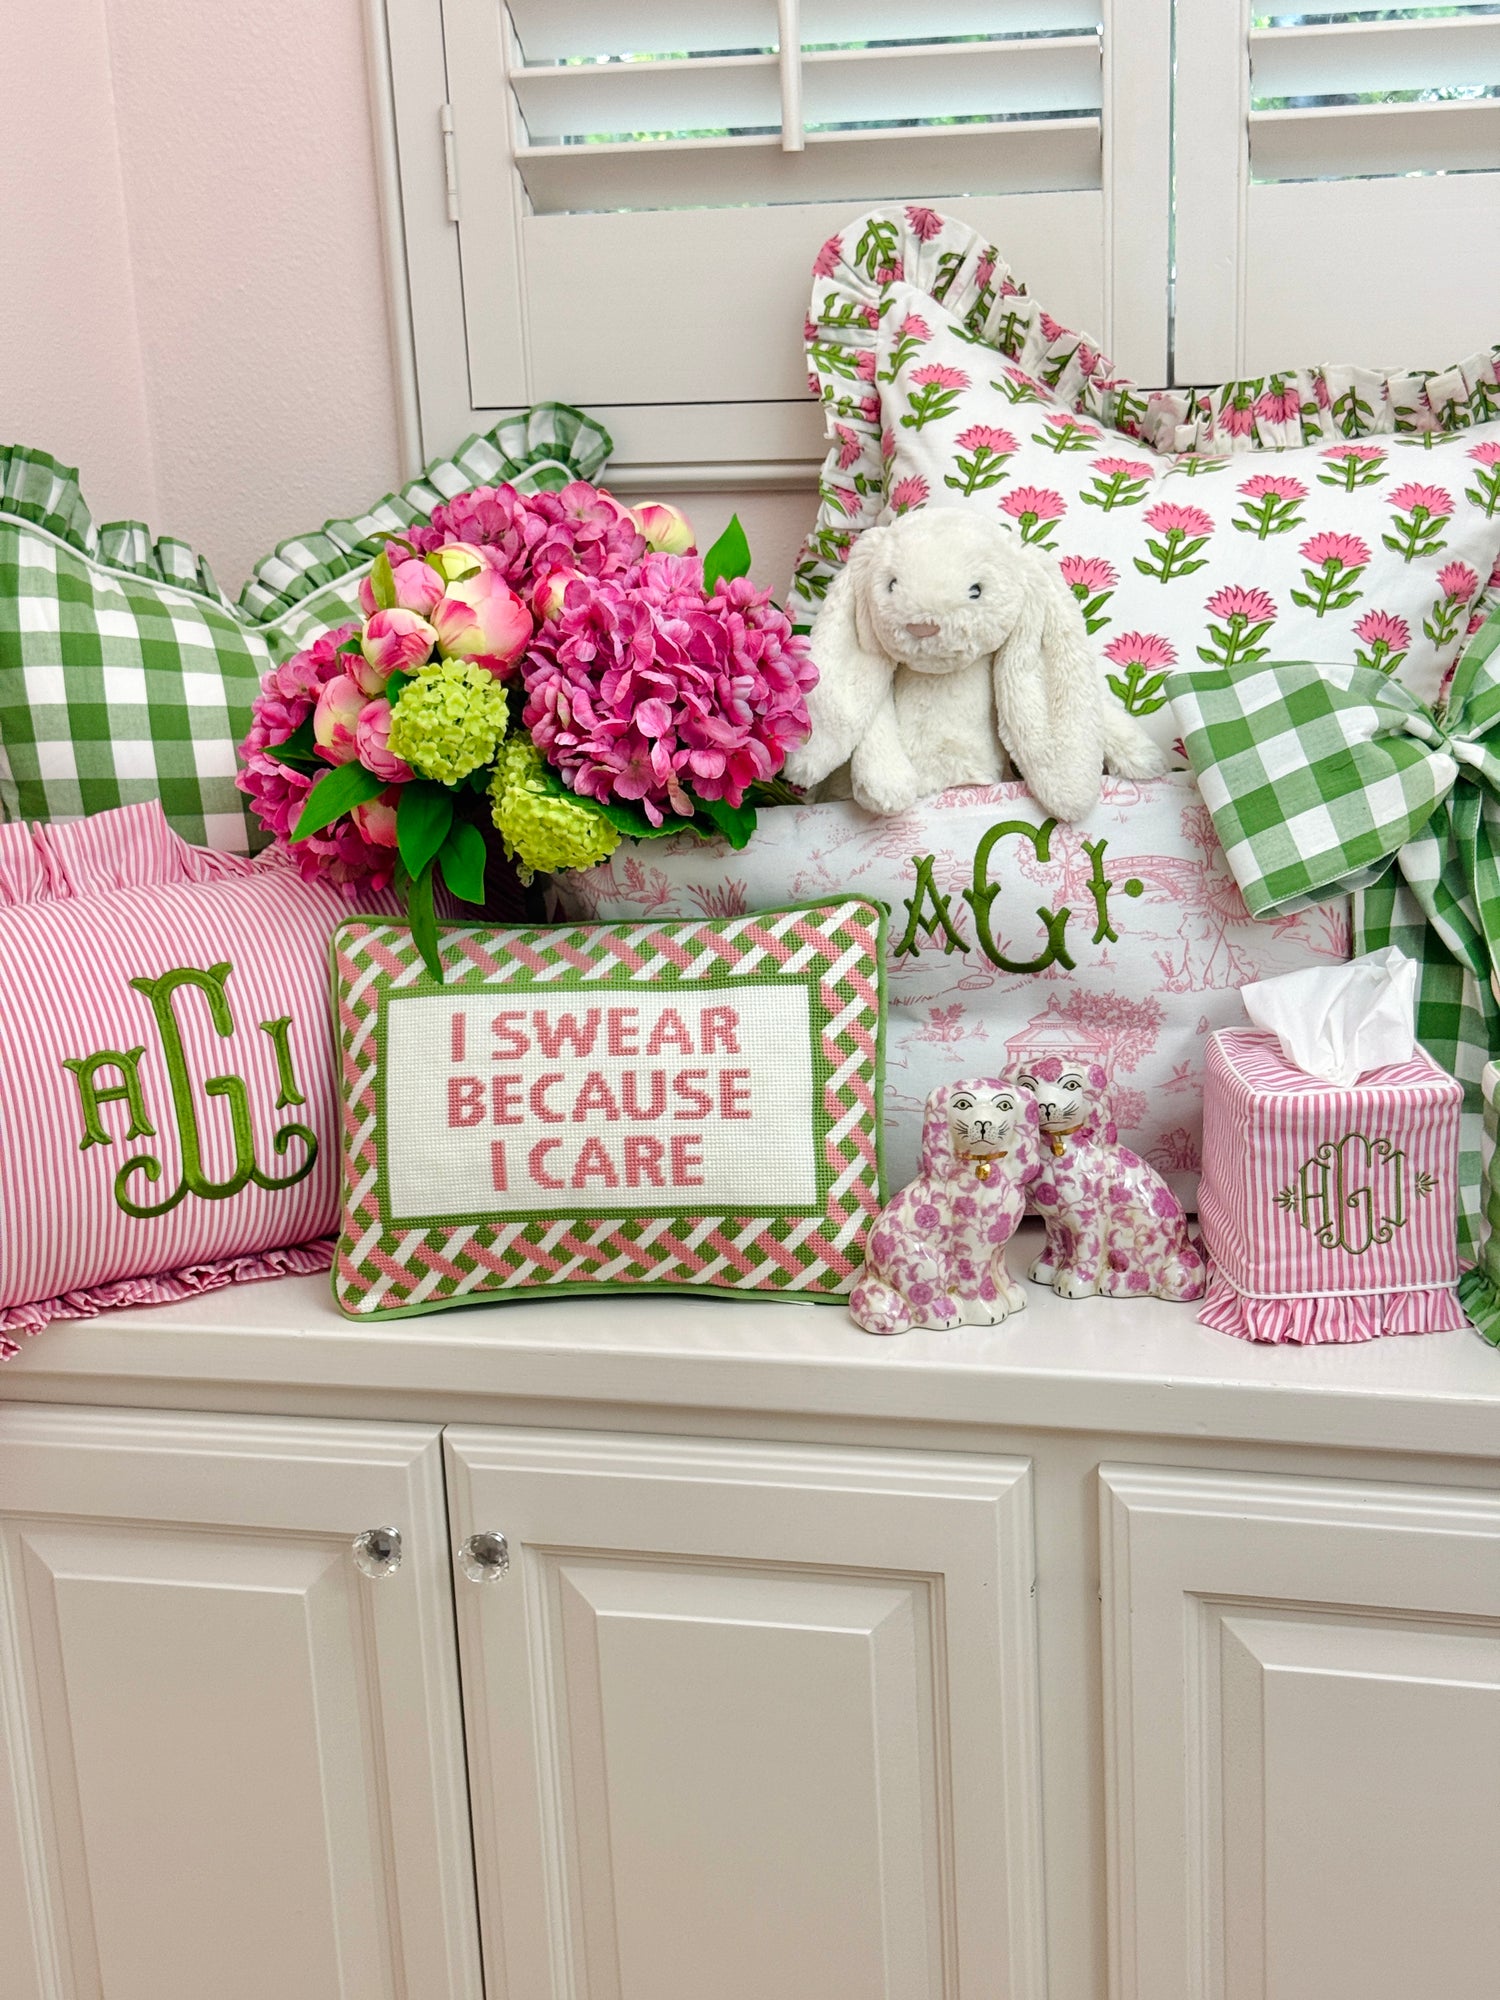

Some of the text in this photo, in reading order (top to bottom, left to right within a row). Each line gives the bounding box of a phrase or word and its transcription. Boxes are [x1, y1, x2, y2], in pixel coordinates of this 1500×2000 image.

[451, 1005, 741, 1063] I SWEAR
[62, 961, 318, 1219] AGI
[448, 1068, 752, 1128] BECAUSE
[490, 1133, 705, 1192] I CARE
